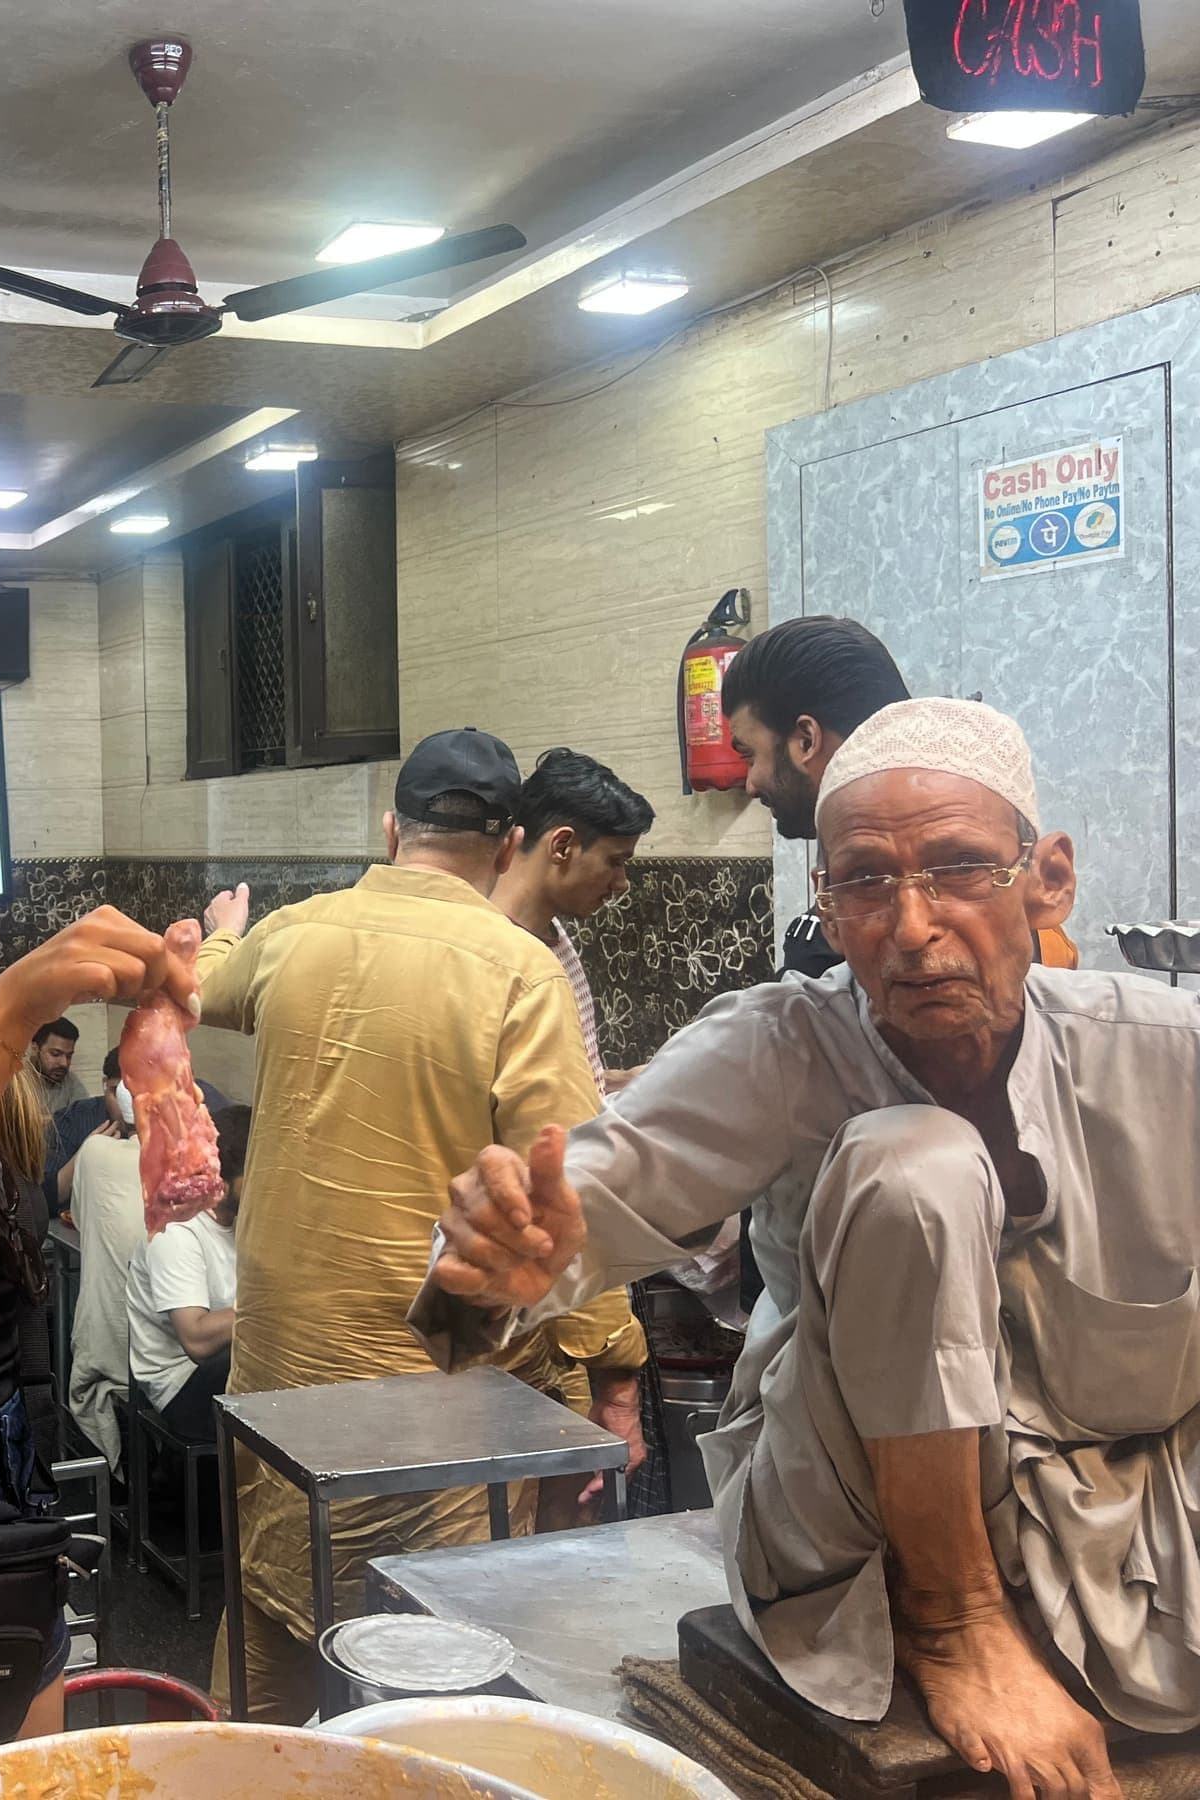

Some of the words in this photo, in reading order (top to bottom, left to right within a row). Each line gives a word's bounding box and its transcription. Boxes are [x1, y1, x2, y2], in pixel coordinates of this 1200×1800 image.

[953, 0, 1103, 87] CASH
[984, 462, 1046, 500] Cash
[1056, 447, 1119, 483] Only
[984, 508, 995, 520] No
[1034, 496, 1061, 510] Phone
[1093, 482, 1120, 501] Paytm
